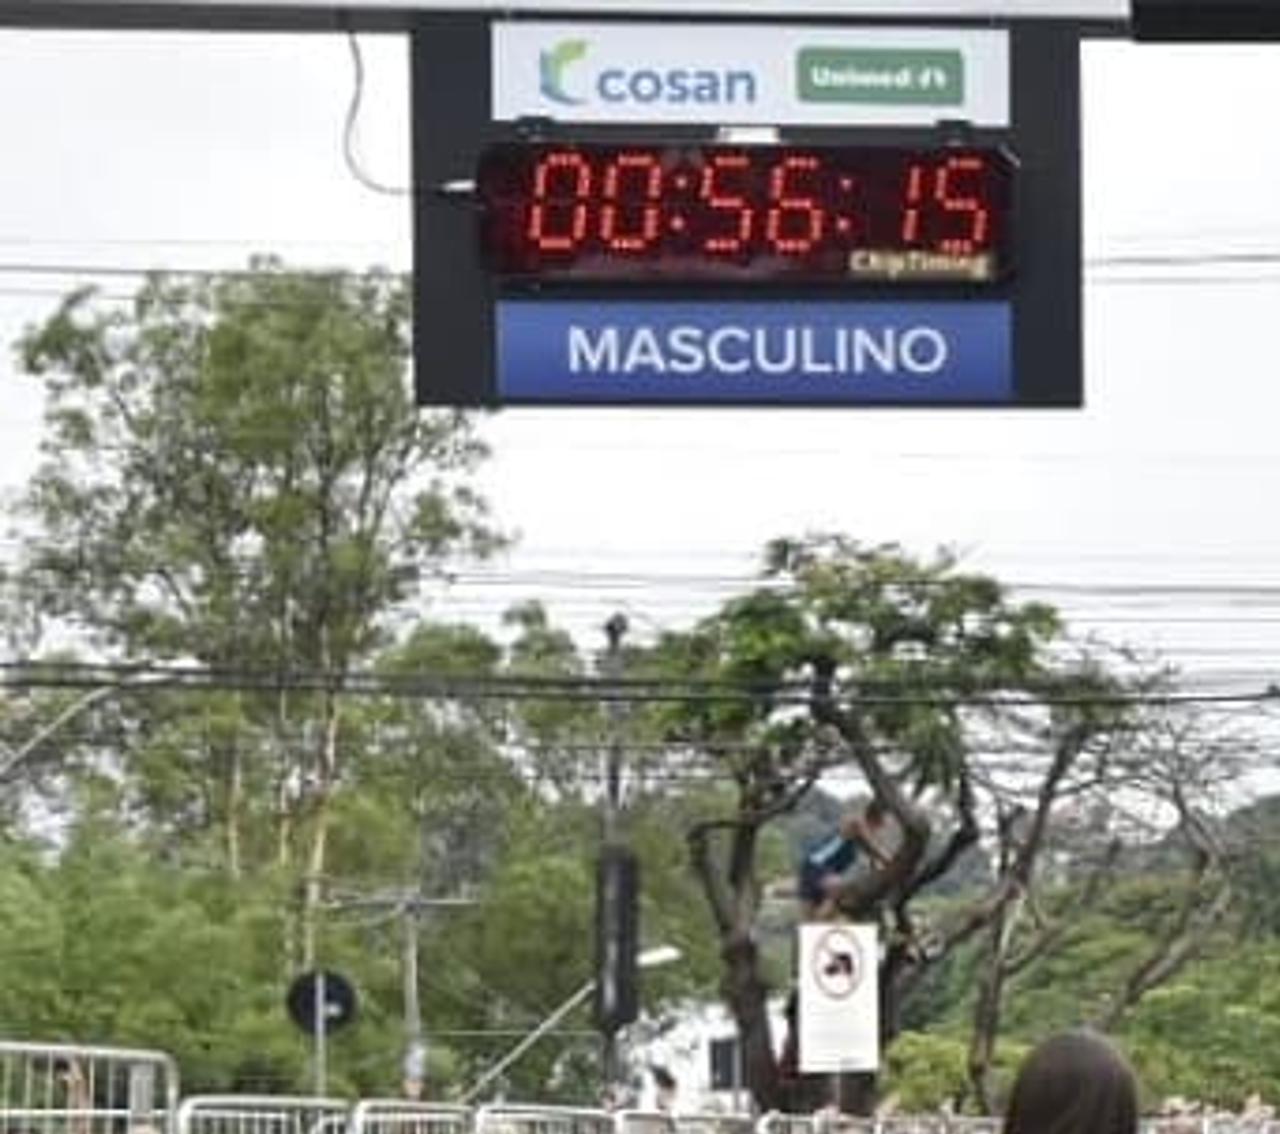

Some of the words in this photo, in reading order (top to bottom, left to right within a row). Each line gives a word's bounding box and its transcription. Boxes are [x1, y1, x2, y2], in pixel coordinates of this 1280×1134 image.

[598, 68, 756, 104] cosan
[811, 66, 911, 88] Unimed
[528, 151, 988, 253] 00:56:15
[849, 251, 988, 279] ChipTiming
[567, 327, 947, 374] MASCULINO
